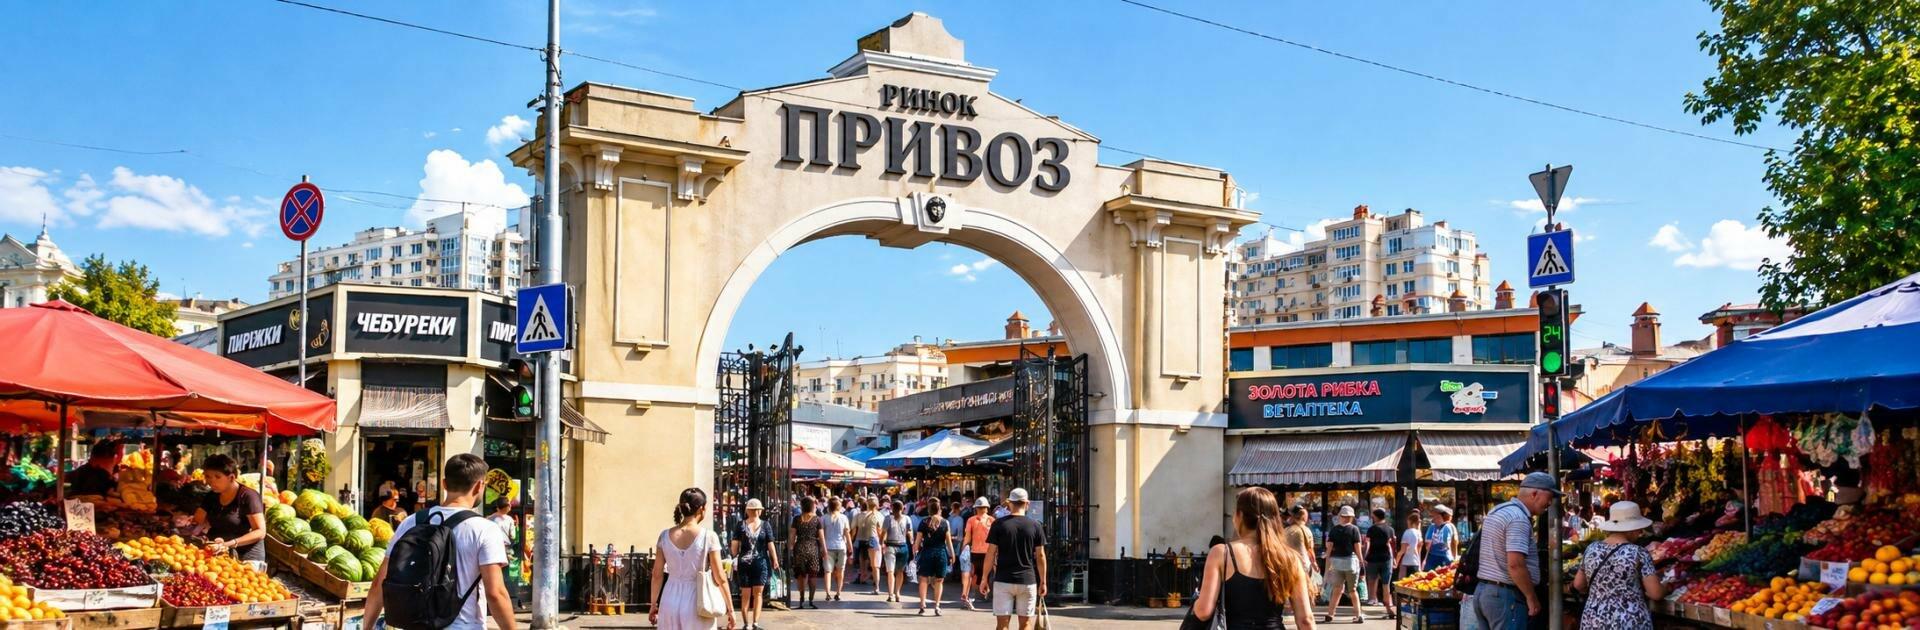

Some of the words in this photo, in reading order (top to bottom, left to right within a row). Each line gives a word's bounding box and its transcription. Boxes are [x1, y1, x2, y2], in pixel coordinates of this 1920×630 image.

[882, 83, 978, 117] РИНОК
[780, 102, 1071, 192] ПРИВОЗ
[357, 312, 457, 336] ЧЕБУРЕКИ
[490, 320, 517, 344] ПИР
[1543, 325, 1561, 343] 24
[227, 324, 282, 354] ПИРІЖКИ
[1248, 383, 1318, 401] ЗОЛОТА
[1321, 380, 1381, 398] РИБКА
[1263, 401, 1363, 419] ВЕТАПТЕКА
